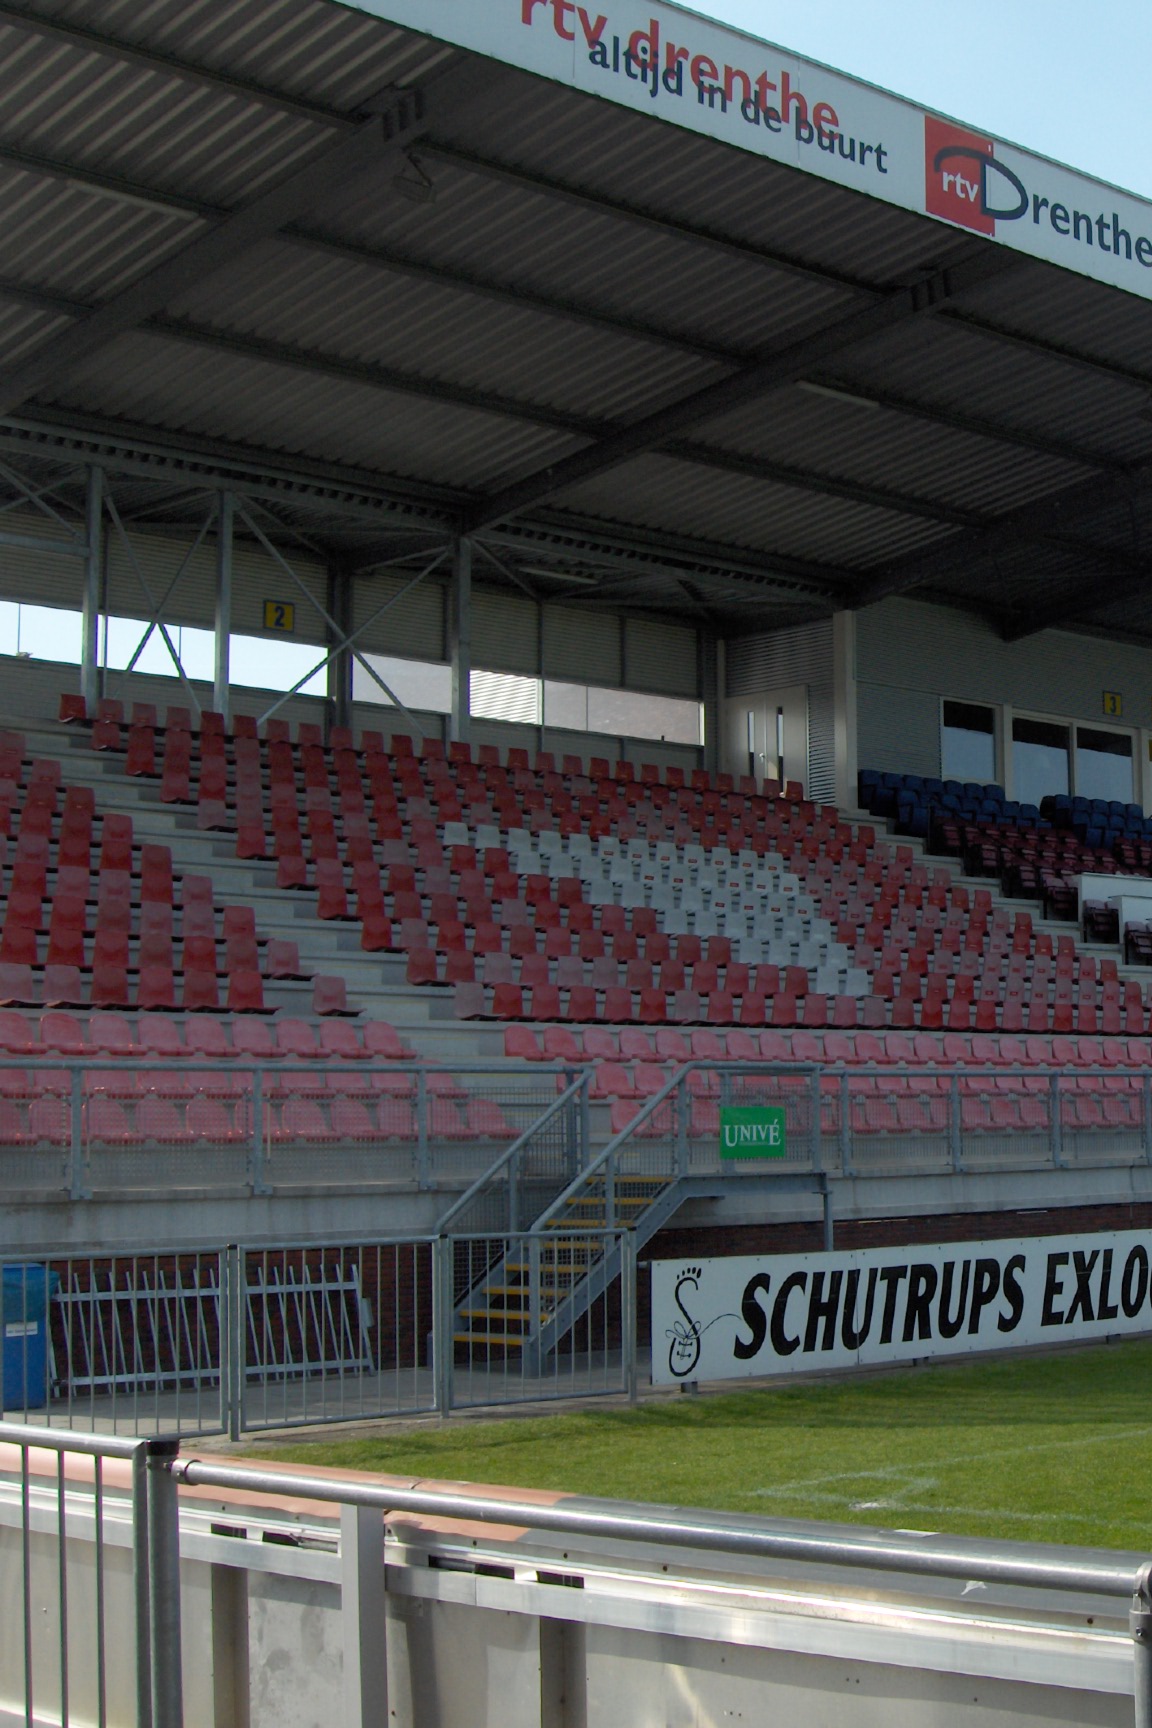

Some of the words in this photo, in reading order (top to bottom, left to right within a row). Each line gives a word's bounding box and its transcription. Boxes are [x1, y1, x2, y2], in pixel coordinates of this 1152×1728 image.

[521, 0, 608, 49] rtv
[628, 18, 840, 142] drenthe
[589, 35, 683, 98] altijd
[698, 69, 726, 115] in
[741, 82, 782, 134] de
[795, 105, 888, 175] buurt
[942, 170, 979, 203] rtv
[274, 605, 286, 628] 2
[1109, 696, 1117, 714] 3
[724, 1119, 781, 1147] UNIVÉ
[734, 1253, 1026, 1360] SCHUTRUPS
